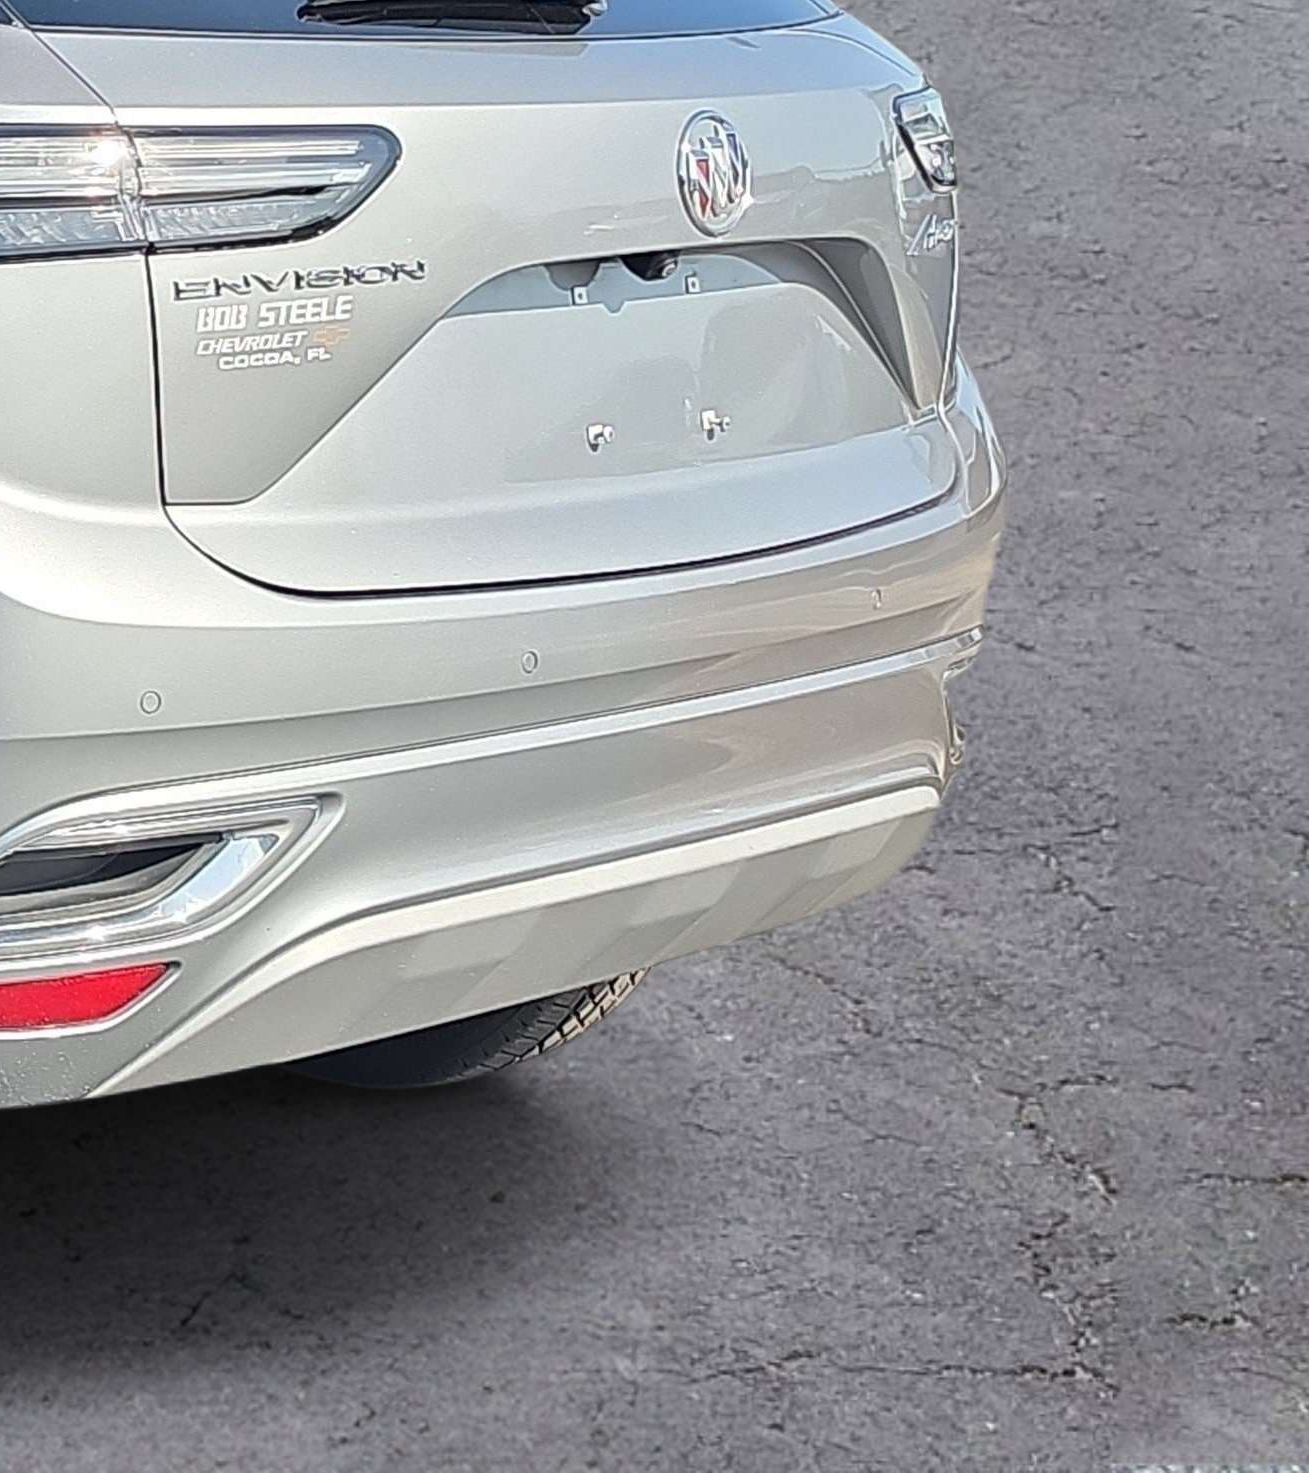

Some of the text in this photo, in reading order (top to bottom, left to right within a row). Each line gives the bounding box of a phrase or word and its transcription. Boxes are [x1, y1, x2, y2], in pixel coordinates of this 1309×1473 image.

[172, 259, 426, 301] ENVISION
[196, 295, 354, 333] BOB STEELE
[196, 330, 308, 356] CHEVROLET
[218, 346, 332, 371] COCOA, FL
